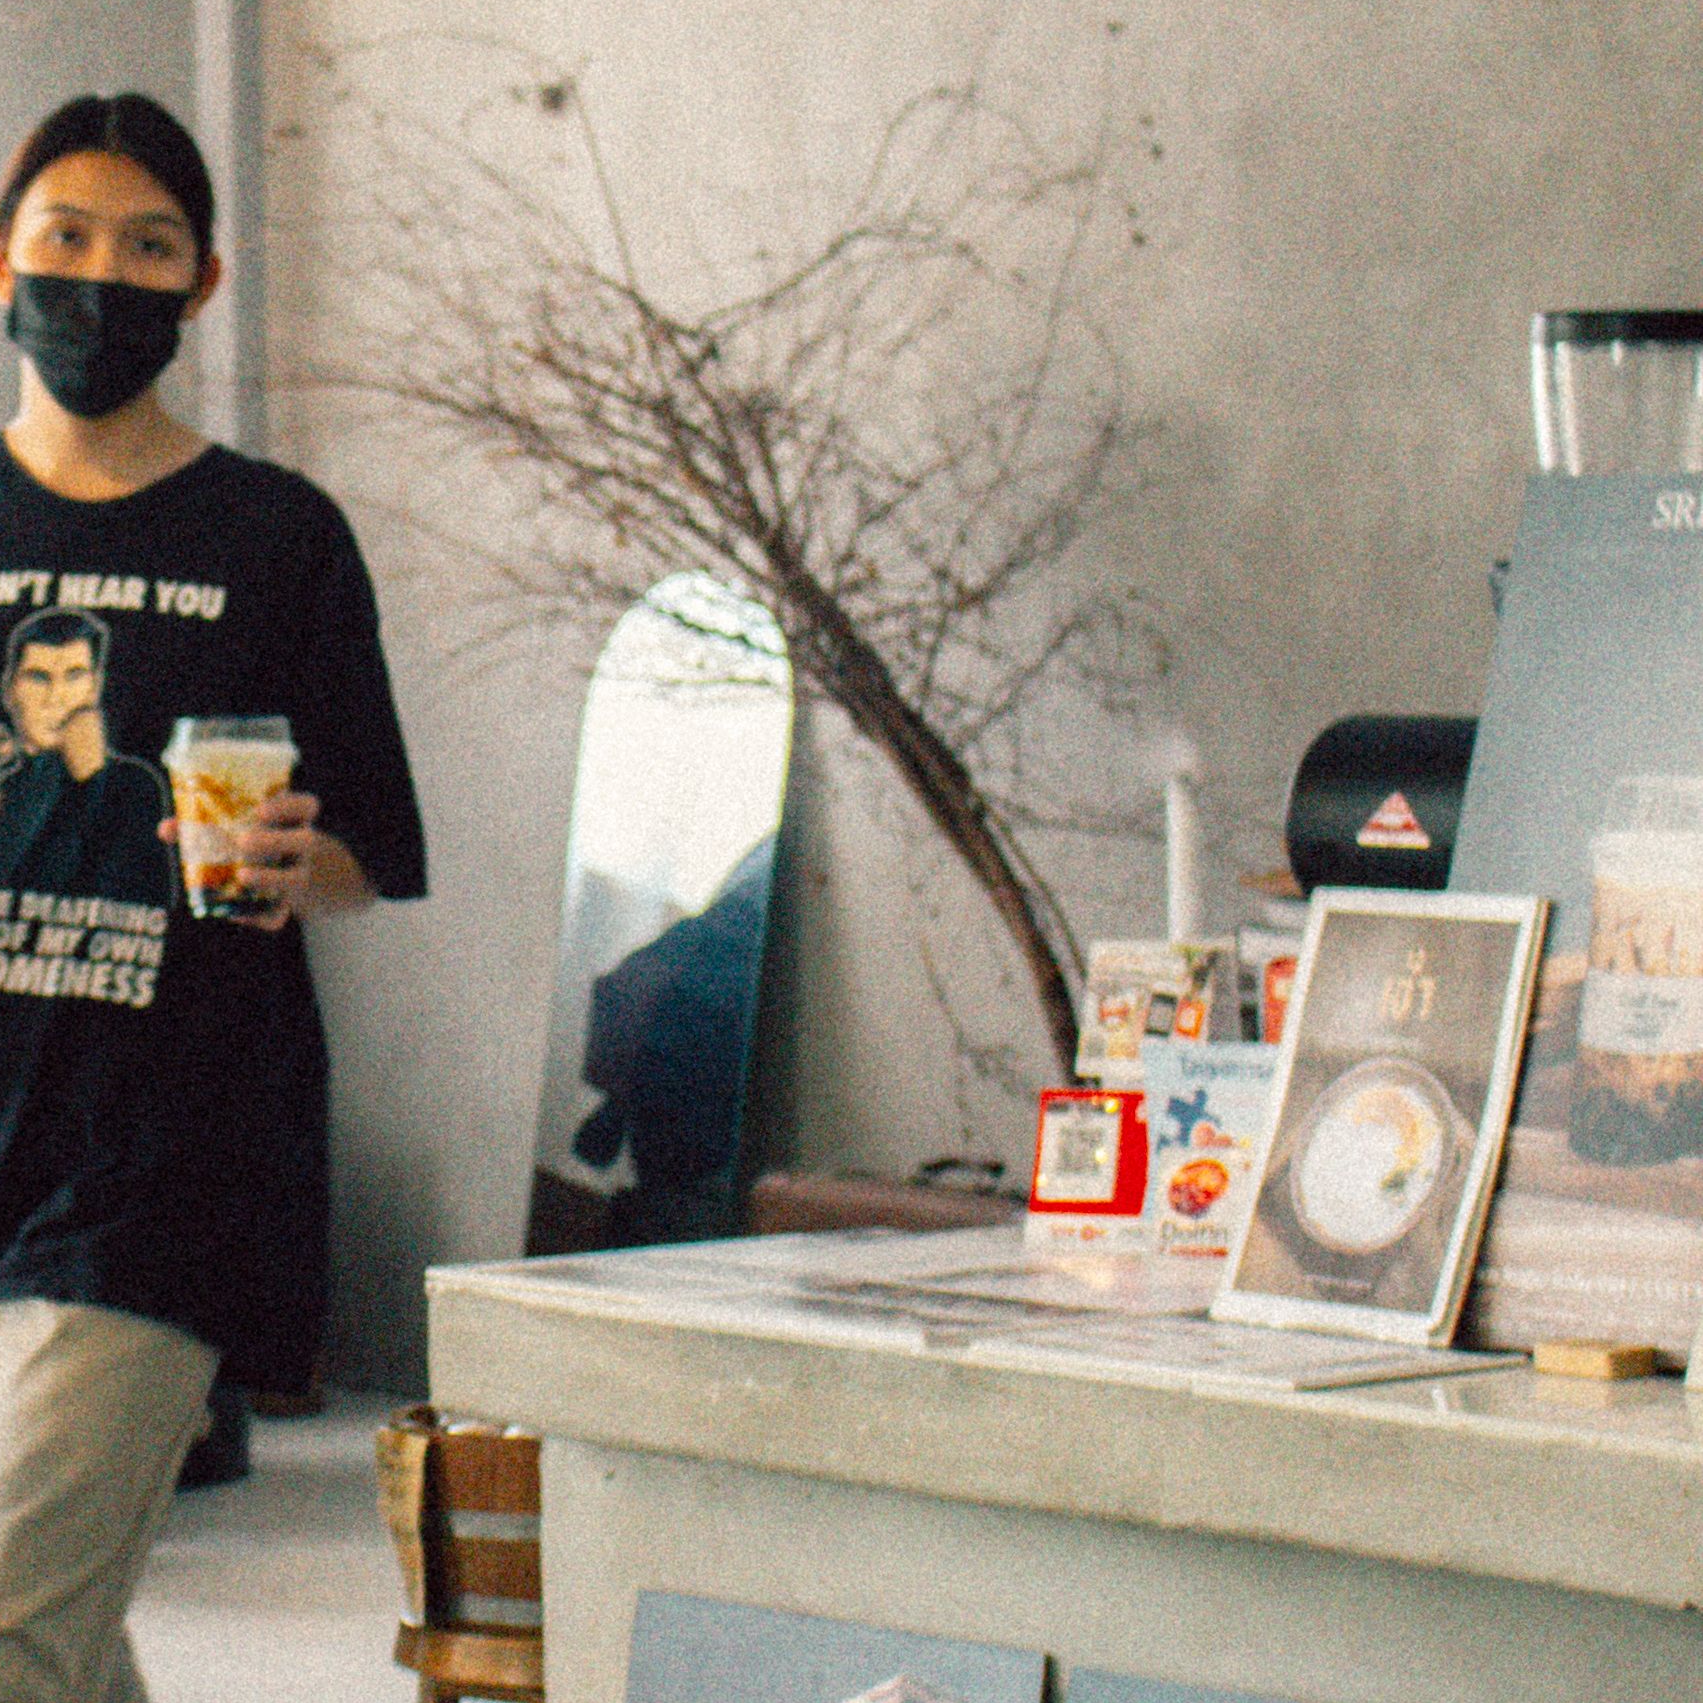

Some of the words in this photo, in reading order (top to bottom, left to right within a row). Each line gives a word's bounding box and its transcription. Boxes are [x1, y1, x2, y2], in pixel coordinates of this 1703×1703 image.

[1651, 489, 1703, 533] SR
[57, 571, 146, 610] HEAR
[155, 579, 225, 621] YOU
[35, 925, 87, 957] MY
[88, 929, 165, 970] OWN
